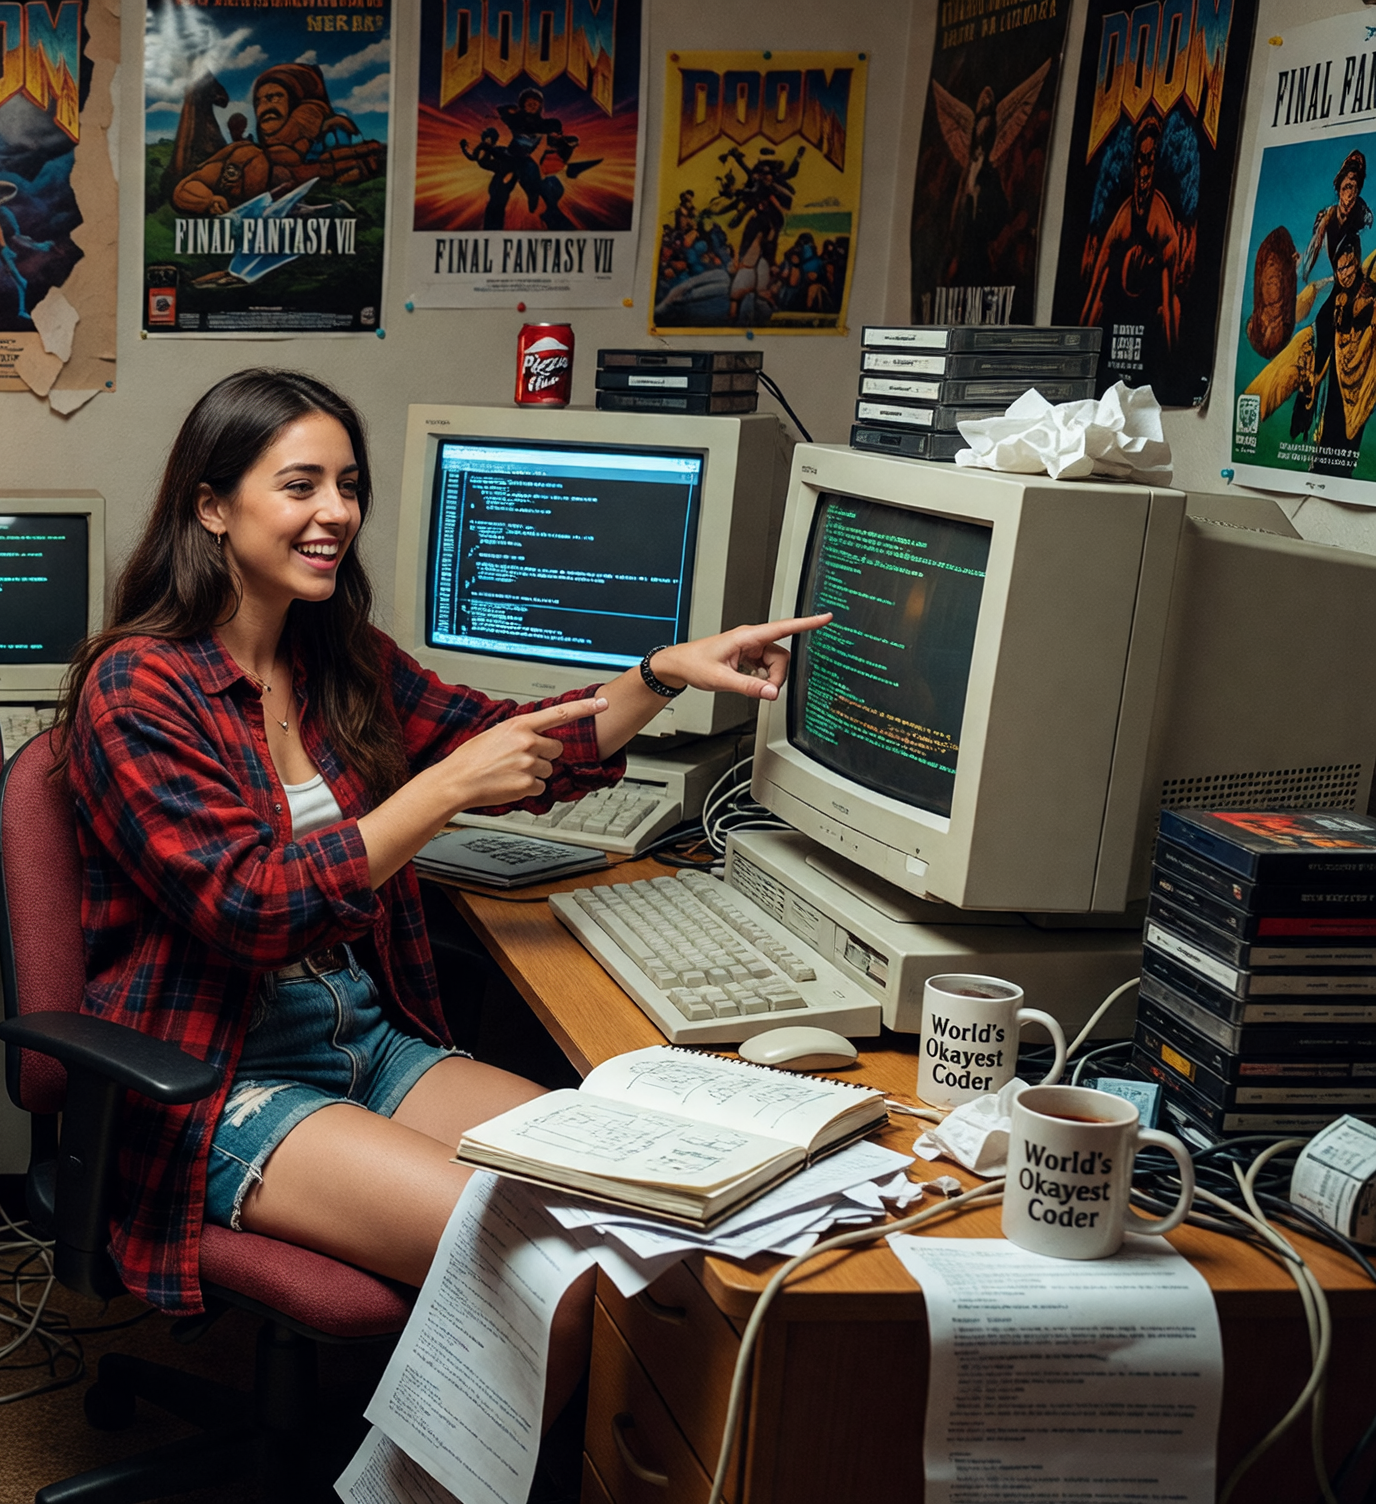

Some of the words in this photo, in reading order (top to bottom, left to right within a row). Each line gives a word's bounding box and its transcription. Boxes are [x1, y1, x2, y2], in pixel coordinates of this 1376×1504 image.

[440, 0, 618, 118] DOOM
[1085, 0, 1235, 166] DOOM
[1271, 60, 1333, 128] FINAL
[677, 67, 855, 174] DOOM
[175, 218, 235, 254] FINAL
[334, 218, 357, 254] VII
[434, 238, 493, 274] FINAL
[501, 238, 587, 274] FANTASY
[593, 238, 615, 274] VII
[931, 1012, 1005, 1043] World's
[926, 1037, 1003, 1069] Okayest
[932, 1063, 993, 1091] Coder
[1024, 1139, 1113, 1175] World's
[1019, 1167, 1111, 1206] Okayest
[1028, 1198, 1100, 1228] Coder
